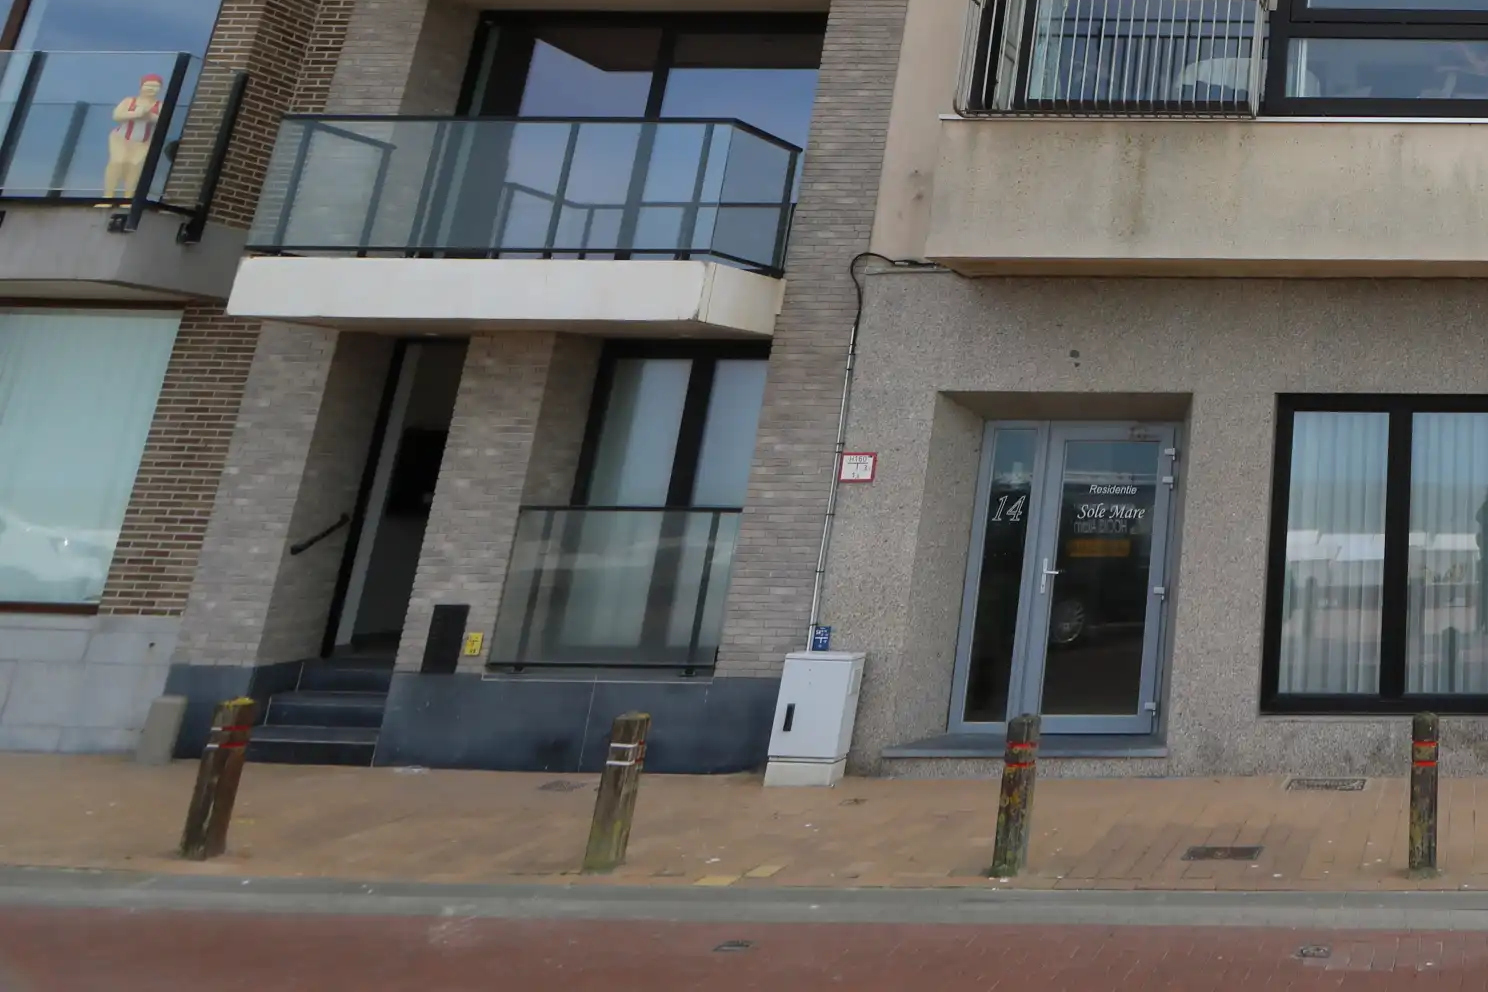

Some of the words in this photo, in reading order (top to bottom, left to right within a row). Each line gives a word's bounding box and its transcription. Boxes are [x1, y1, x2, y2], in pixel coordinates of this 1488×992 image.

[1089, 484, 1138, 495] Residentie
[991, 495, 1026, 522] 14
[1077, 502, 1106, 520] Sole
[1109, 505, 1146, 520] Mare
